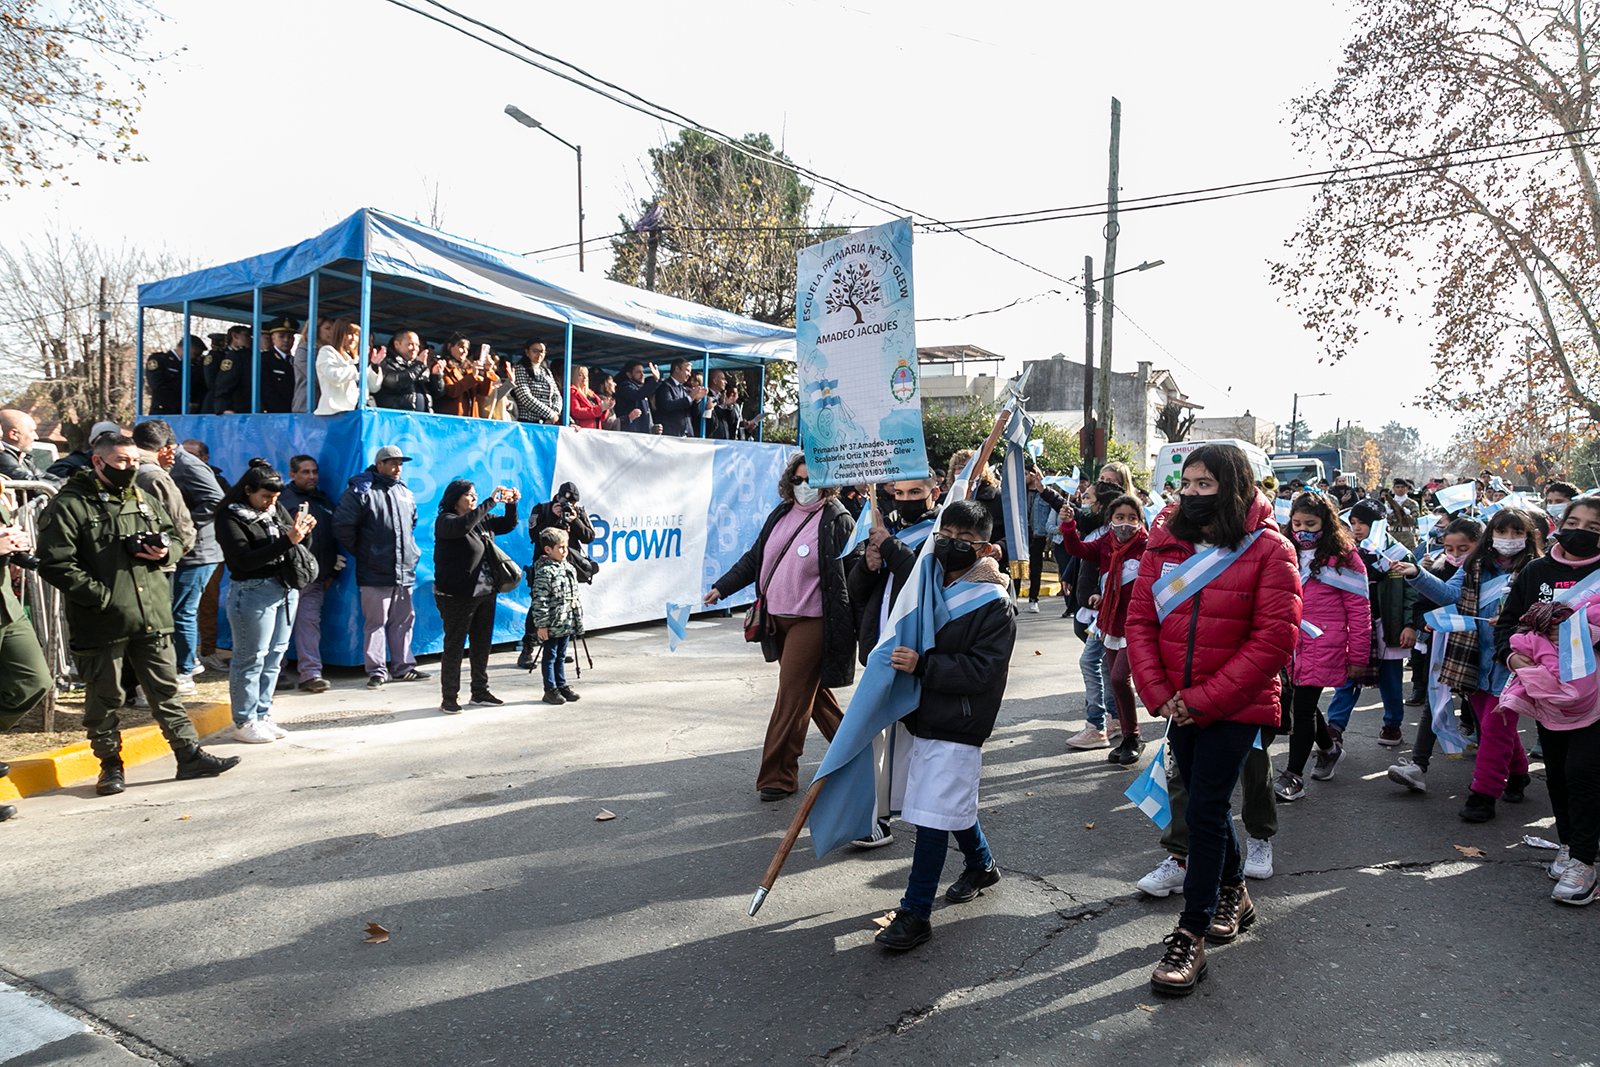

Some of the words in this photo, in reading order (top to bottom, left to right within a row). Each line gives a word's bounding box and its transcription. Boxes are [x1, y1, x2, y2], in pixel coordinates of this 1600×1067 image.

[803, 273, 824, 321] ESCUELA
[822, 243, 866, 273] PRIMARIA
[893, 265, 909, 299] GLEW
[816, 328, 855, 345] AMADEO
[857, 320, 898, 337] JACQUES
[813, 445, 839, 455] Primaria
[886, 437, 915, 446] Jacques
[814, 453, 846, 464] Scalabrini
[846, 451, 862, 460] Ortiz
[893, 446, 911, 455] Glew
[839, 460, 869, 470] Almirante
[870, 458, 892, 467] Brown
[834, 471, 857, 479] Creada
[613, 514, 684, 529] ALMIRANTE
[587, 517, 682, 564] Brown
